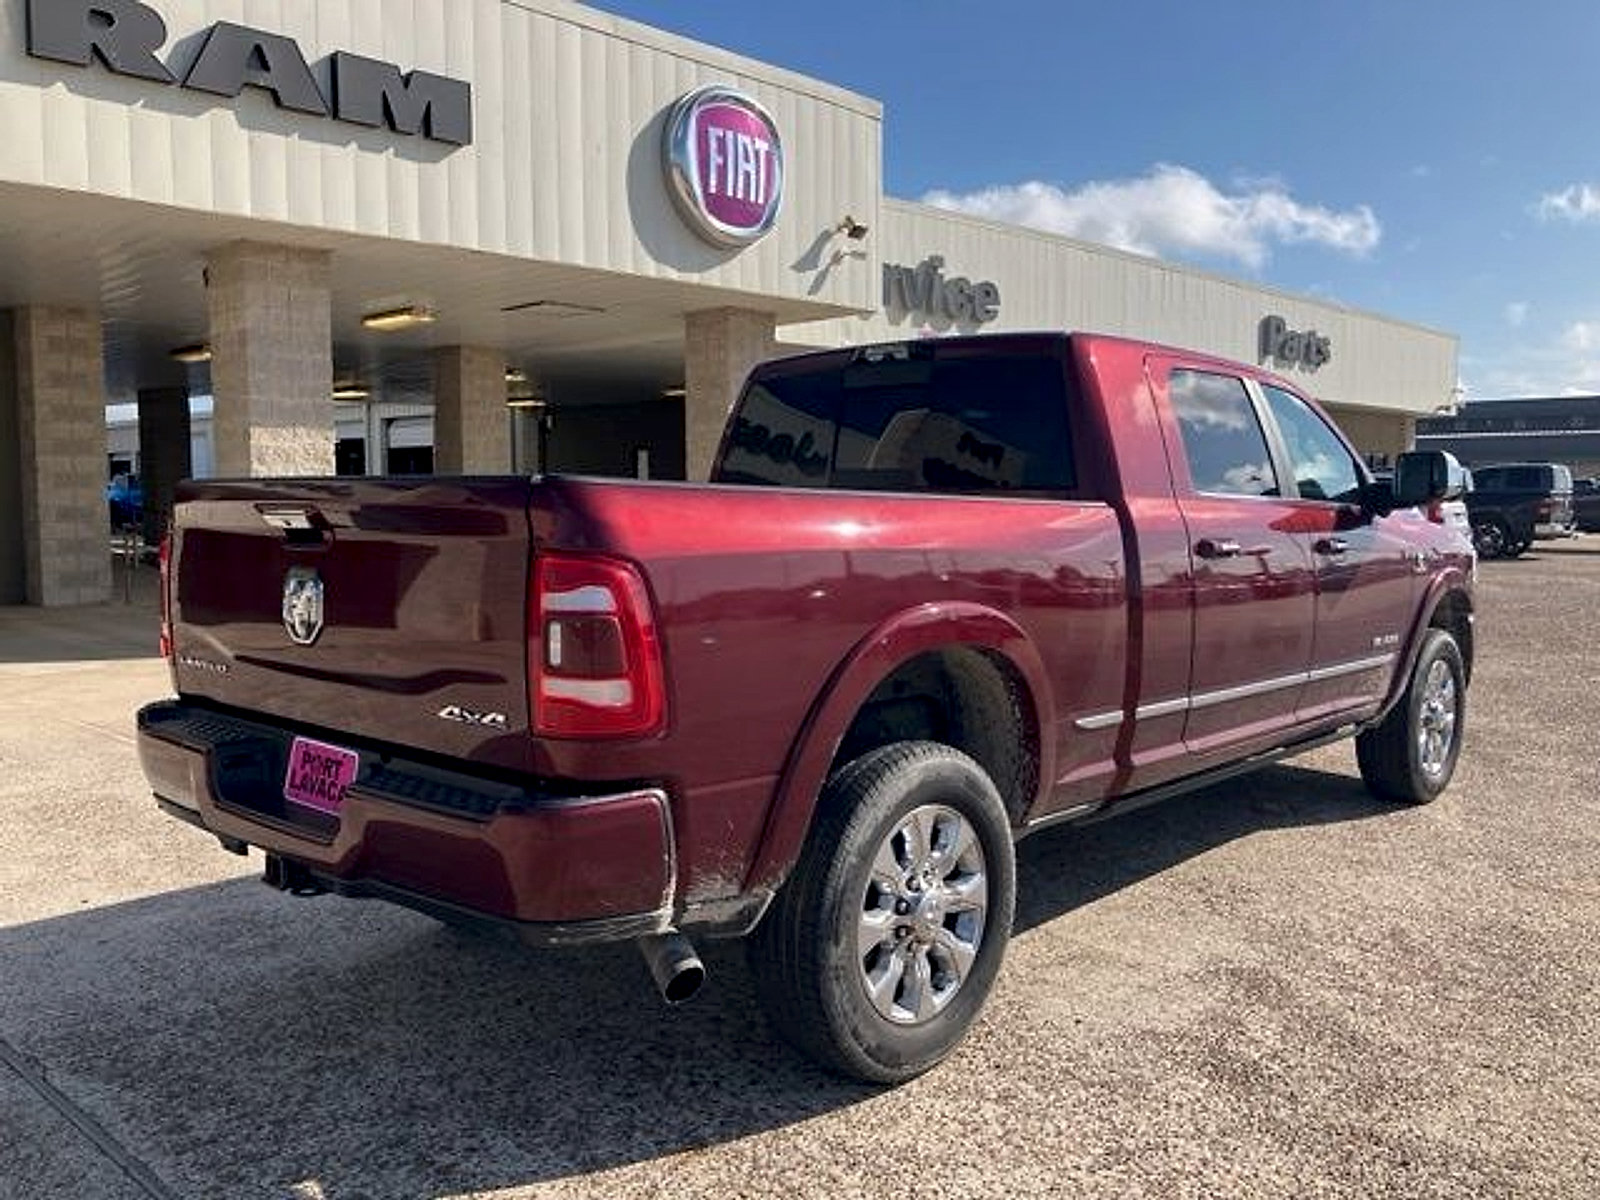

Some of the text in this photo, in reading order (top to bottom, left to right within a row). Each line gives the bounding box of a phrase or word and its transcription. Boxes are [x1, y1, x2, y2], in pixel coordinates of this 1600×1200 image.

[26, 0, 471, 146] RAM
[707, 127, 769, 204] FIAT
[1258, 315, 1331, 368] Parts
